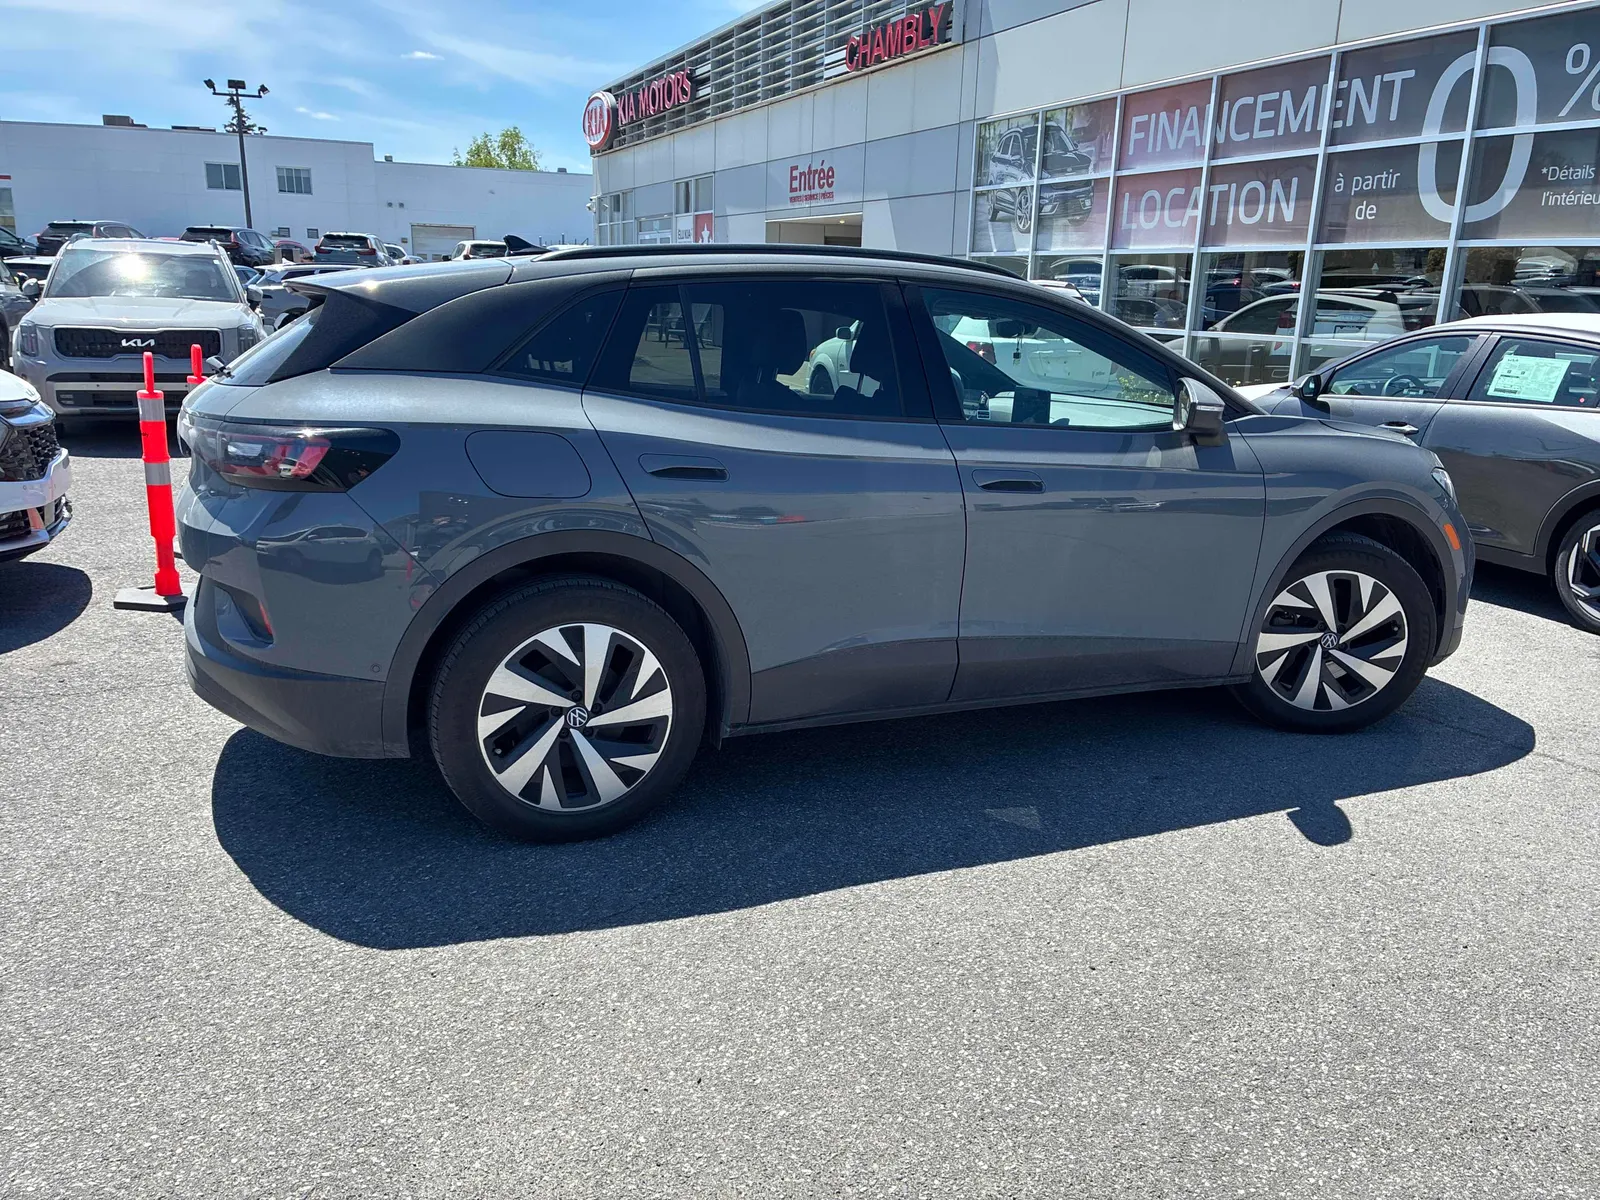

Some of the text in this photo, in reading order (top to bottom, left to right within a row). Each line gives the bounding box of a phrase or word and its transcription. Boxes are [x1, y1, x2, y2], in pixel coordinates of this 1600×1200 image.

[845, 3, 945, 72] CHAMBLY
[617, 67, 692, 126] KIA MOTORS
[1128, 69, 1416, 155] FINANCEMENT
[1417, 46, 1538, 223] 0
[789, 160, 835, 193] Entrée
[1121, 176, 1299, 230] LOCATION
[1334, 168, 1401, 196] à partir
[1355, 200, 1377, 220] de
